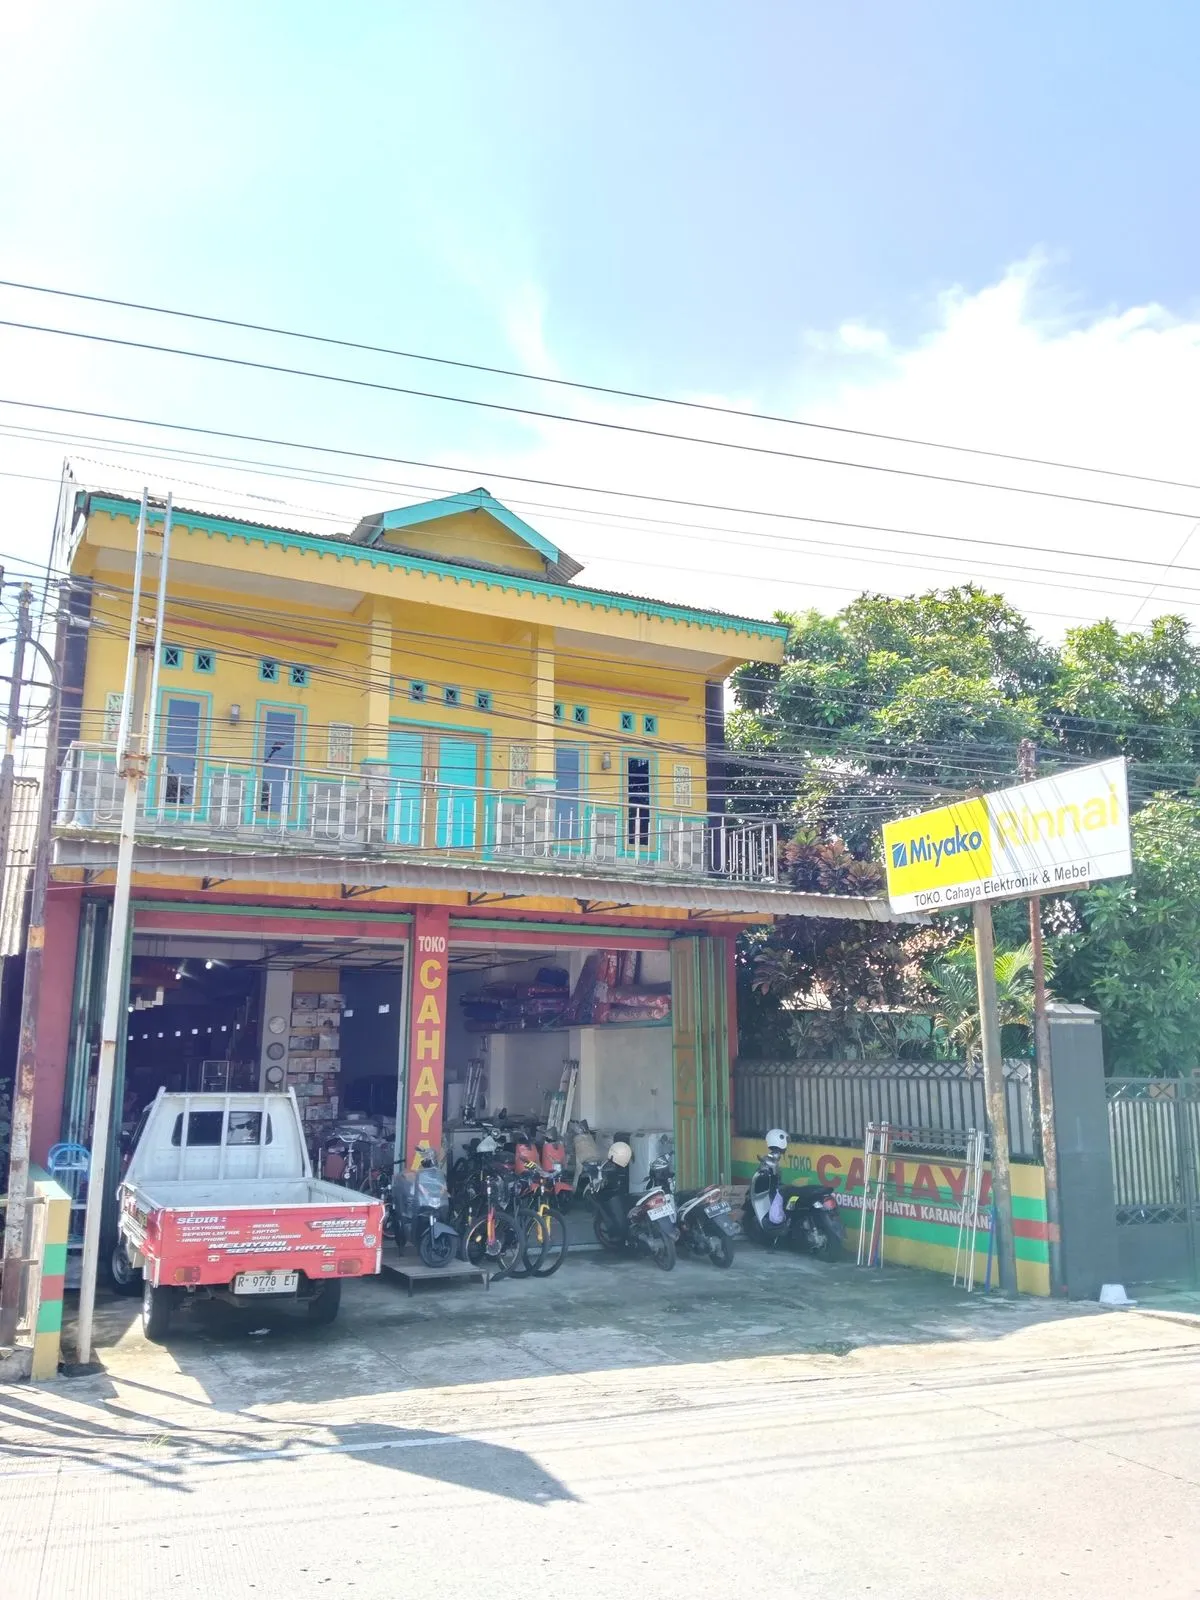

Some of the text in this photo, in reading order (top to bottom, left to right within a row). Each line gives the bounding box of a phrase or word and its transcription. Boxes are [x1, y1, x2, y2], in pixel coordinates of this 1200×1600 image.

[997, 783, 1120, 849] Rinnai
[910, 825, 982, 868] Miyako
[945, 885, 981, 901] Cahaya
[984, 875, 1039, 894] Elektronik
[1042, 872, 1051, 884] &
[1054, 862, 1091, 883] Mebel
[418, 936, 446, 953] TOKO
[787, 1154, 812, 1172] TOKO
[831, 1192, 992, 1229] OEKARNO HATTA KARANGKAN
[176, 1216, 219, 1224] SEDIA
[208, 1240, 287, 1249] MELAYANI
[252, 1275, 277, 1287] 9778
[284, 1275, 296, 1286] ET
